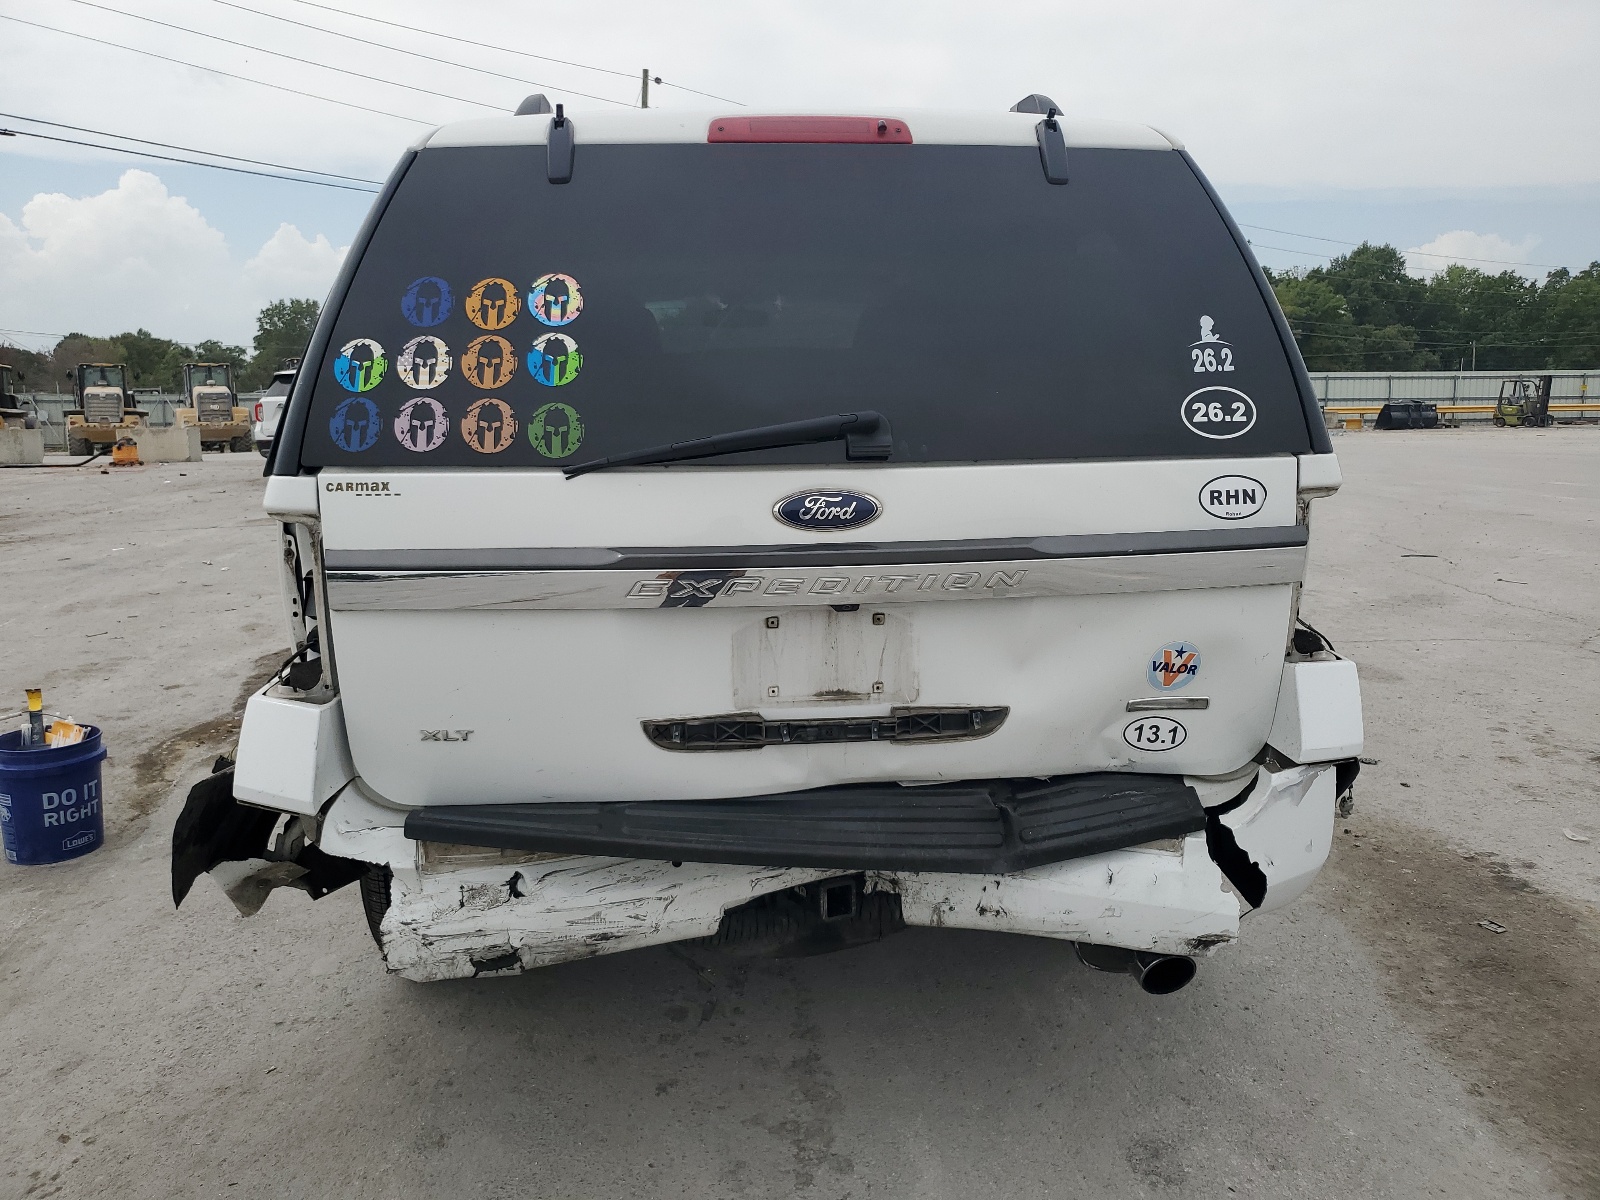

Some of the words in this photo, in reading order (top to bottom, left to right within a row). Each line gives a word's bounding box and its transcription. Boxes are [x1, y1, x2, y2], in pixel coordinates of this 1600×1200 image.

[1191, 347, 1235, 373] 26.2
[1191, 401, 1248, 423] 26.2
[799, 495, 857, 522] Ford
[1209, 488, 1257, 506] RHN
[626, 569, 1030, 599] EXPEDITION
[1152, 660, 1198, 676] VALOR
[420, 729, 475, 741] XLT
[1133, 723, 1179, 745] 13.1
[42, 787, 77, 810] DO
[83, 779, 98, 800] IT
[43, 799, 99, 828] RIGHT
